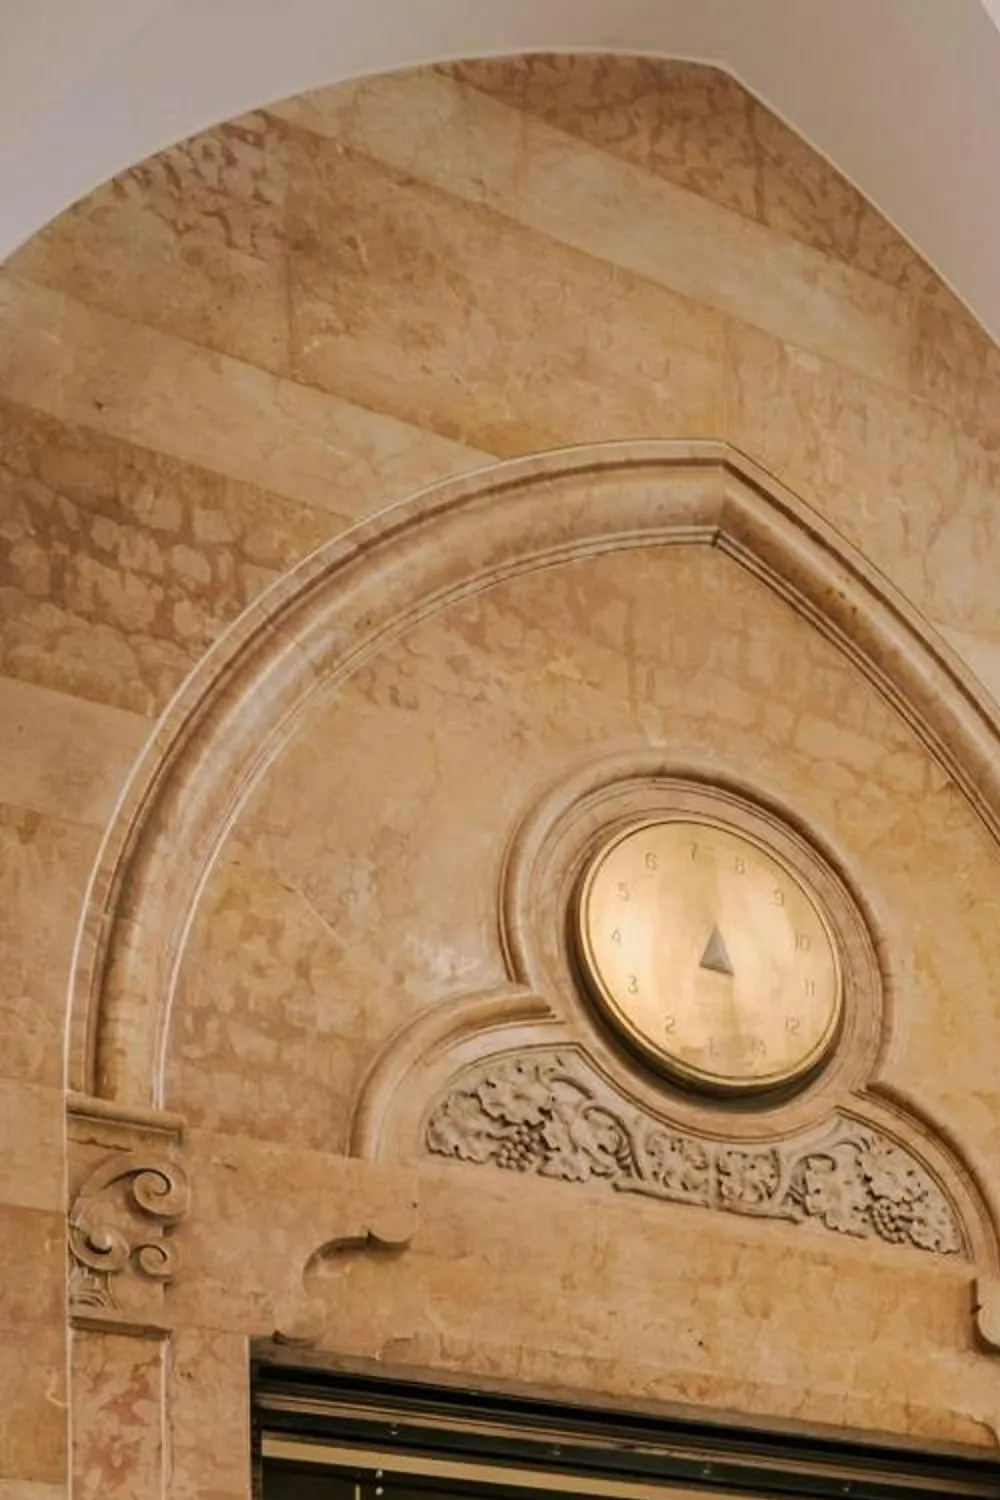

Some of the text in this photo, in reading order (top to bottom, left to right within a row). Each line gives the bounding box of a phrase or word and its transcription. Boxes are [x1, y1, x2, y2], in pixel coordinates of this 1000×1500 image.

[645, 852, 657, 870] 6
[617, 881, 630, 901] 5
[611, 927, 622, 947] 4
[795, 930, 810, 953] 10
[627, 975, 639, 995] 3
[804, 979, 815, 998] 11
[664, 1014, 676, 1036] 2
[785, 1014, 800, 1037] 12
